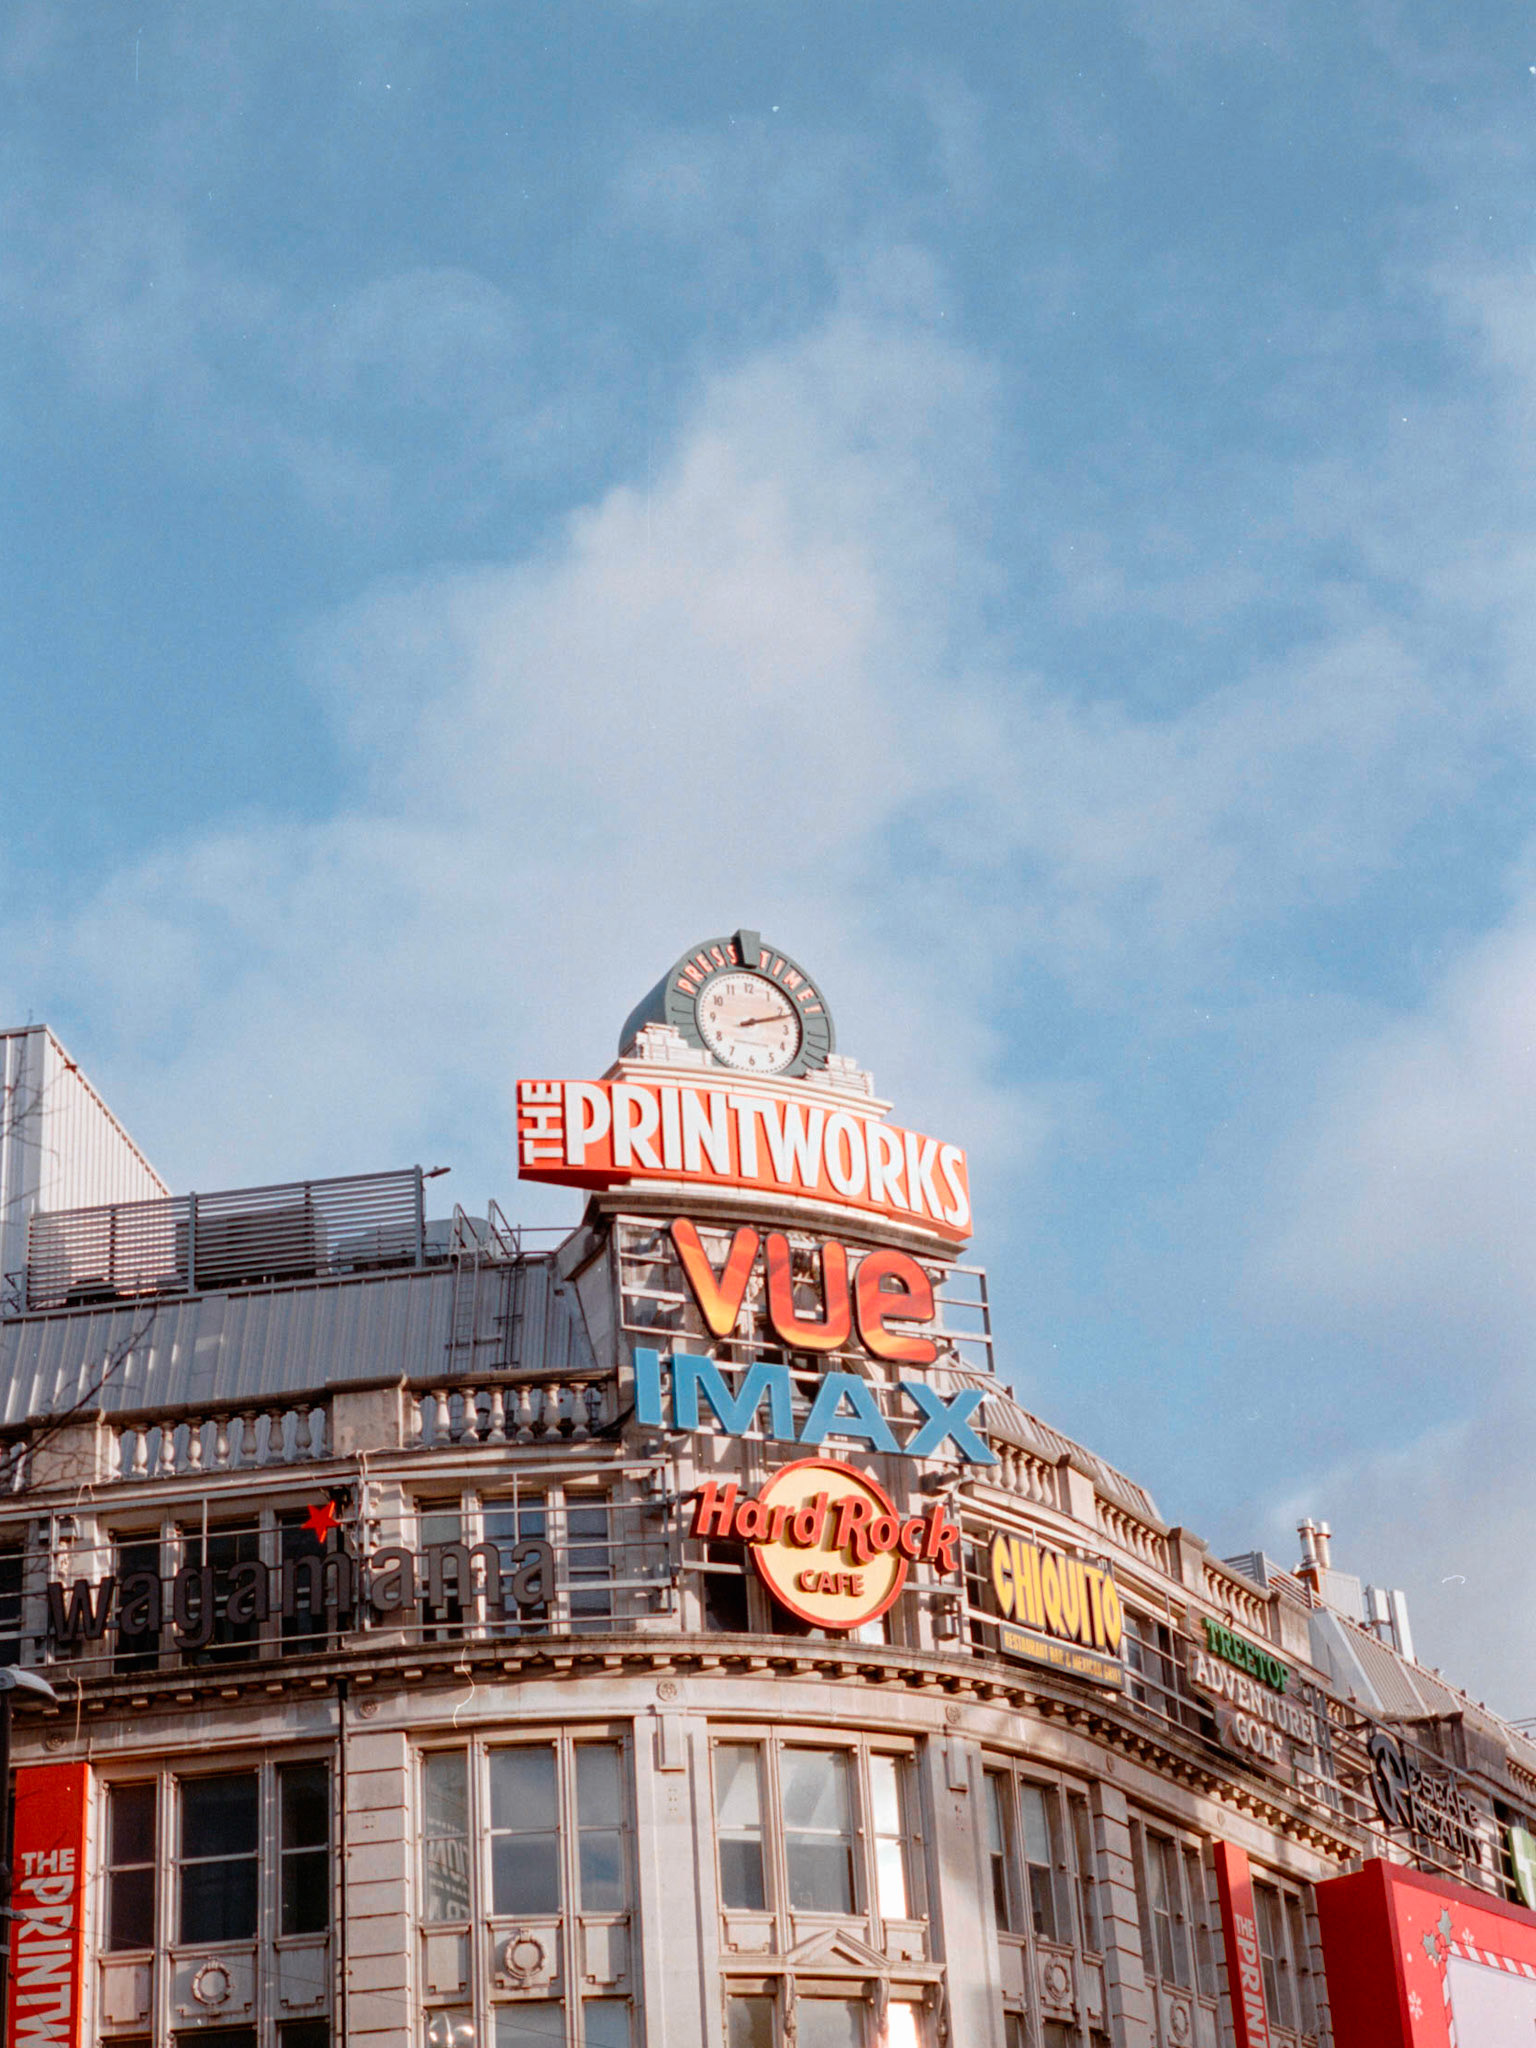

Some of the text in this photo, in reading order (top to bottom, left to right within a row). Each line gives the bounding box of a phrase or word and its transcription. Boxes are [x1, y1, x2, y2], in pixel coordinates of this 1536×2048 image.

[677, 944, 739, 995] PRESS
[726, 983, 736, 996] 11
[743, 982, 754, 995] 12
[713, 995, 724, 1007] 10
[521, 1081, 971, 1228] THE PRINTWORKS
[633, 1346, 999, 1466] IMAX
[694, 1480, 959, 1571] Hard Rock
[48, 1538, 557, 1650] wagamama
[799, 1568, 865, 1596] CAFE
[990, 1530, 1123, 1652] CHIQUITO
[1202, 1617, 1290, 1694] TREETOP
[1194, 1650, 1314, 1747] ADVENTURE
[1234, 1711, 1284, 1765] GOLF
[20, 1847, 76, 1876] THE
[1234, 1912, 1256, 1941] THE
